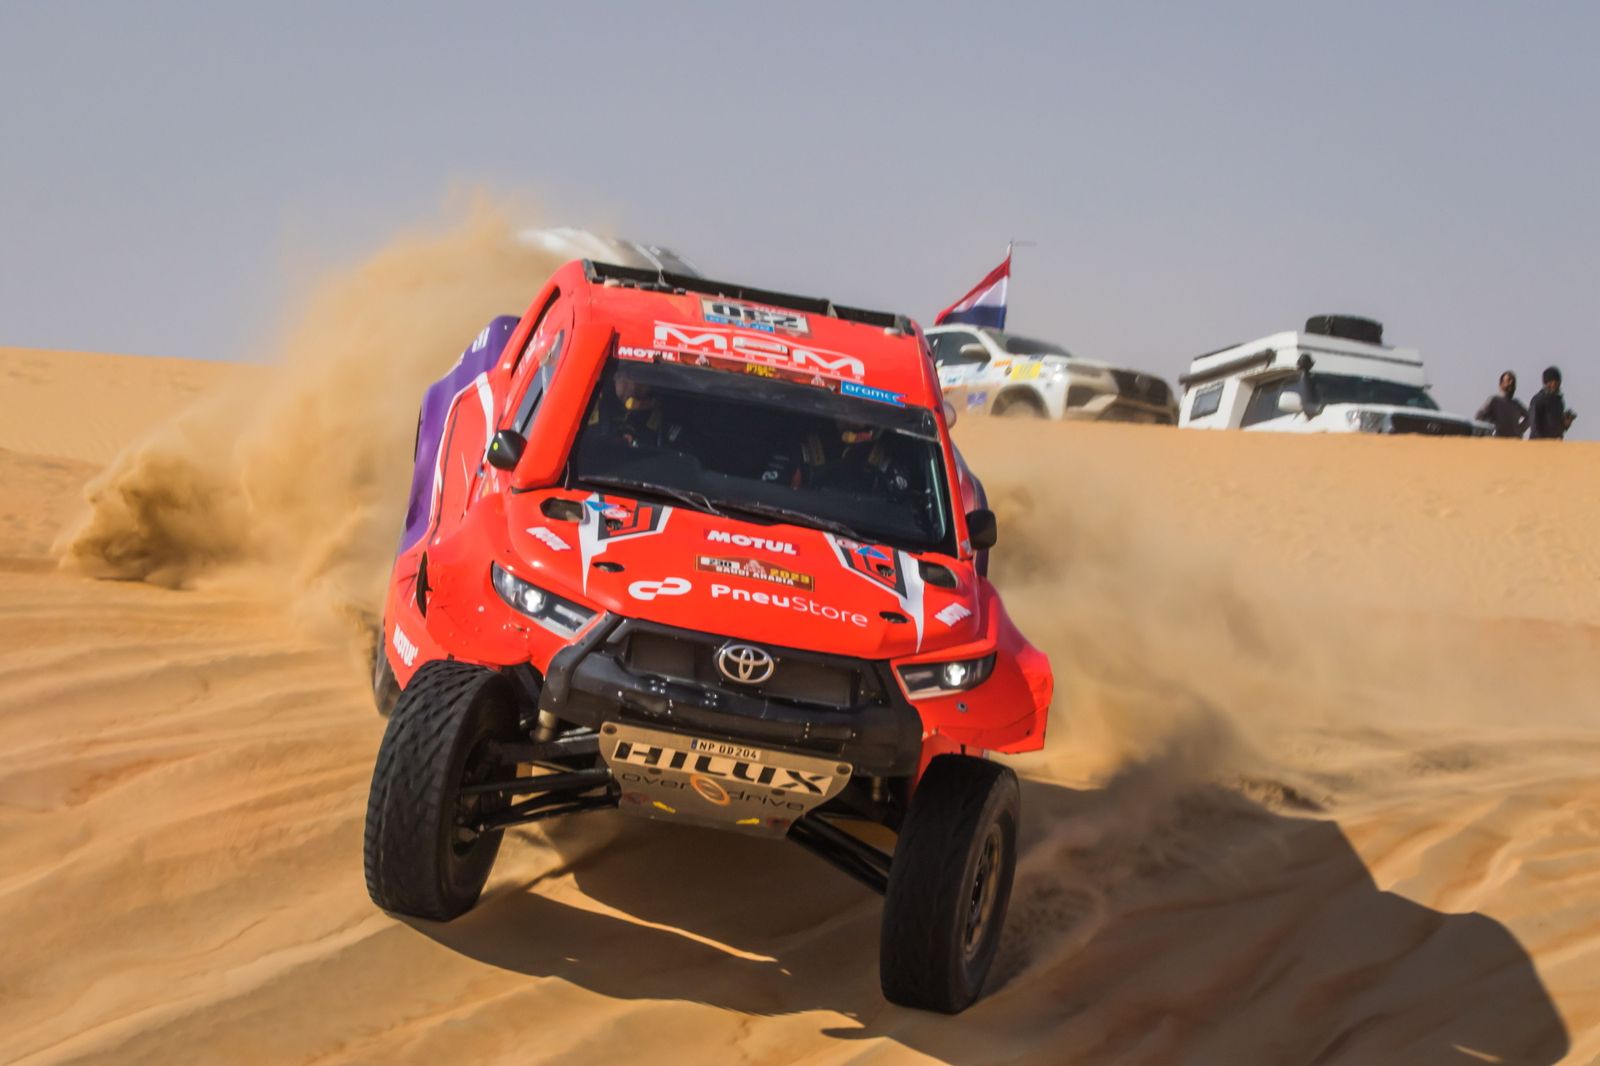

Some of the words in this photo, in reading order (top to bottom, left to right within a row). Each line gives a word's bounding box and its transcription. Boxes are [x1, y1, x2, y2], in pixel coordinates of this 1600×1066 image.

[707, 529, 797, 555] MOTUL
[715, 565, 750, 577] SAUDI
[752, 571, 795, 586] ARABIA
[770, 567, 810, 584] 2023
[710, 583, 869, 628] PneuStore
[699, 741, 715, 751] NP
[614, 741, 826, 796] HILUX
